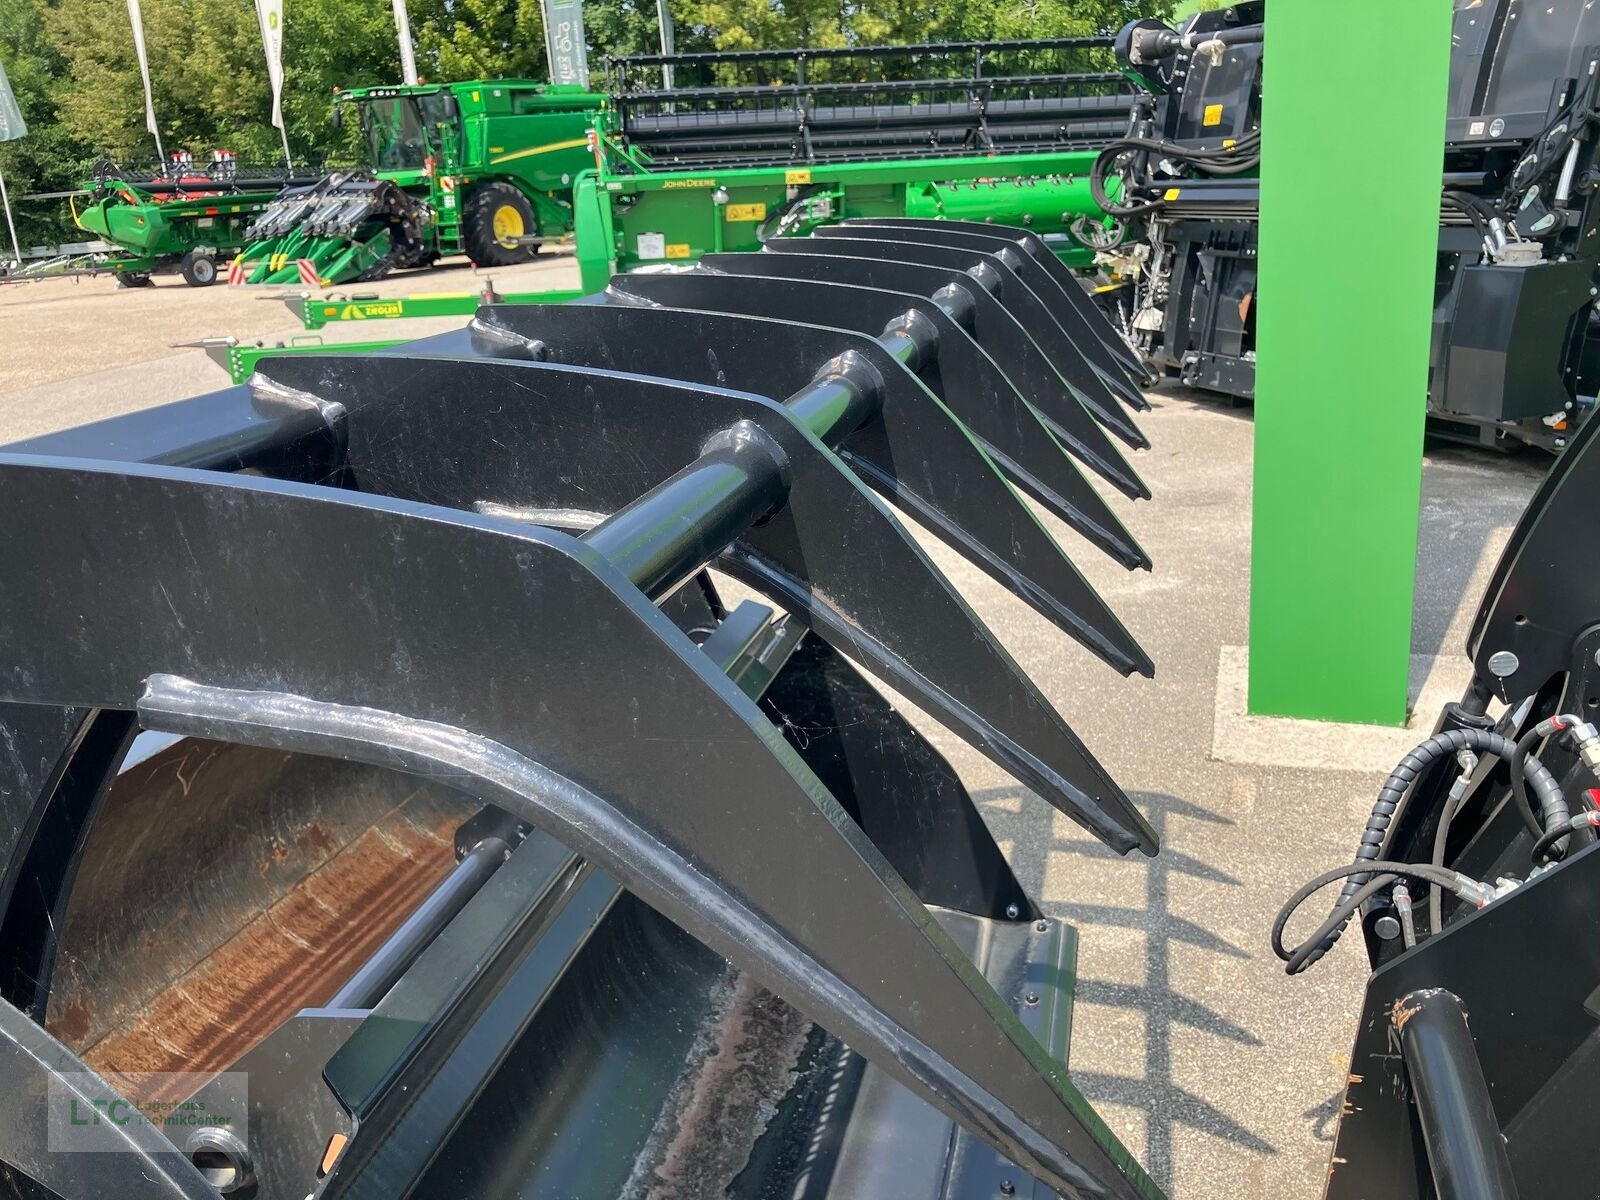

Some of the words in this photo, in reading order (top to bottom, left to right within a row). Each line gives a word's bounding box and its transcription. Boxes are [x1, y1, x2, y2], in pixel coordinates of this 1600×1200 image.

[662, 180, 686, 188] JOHN
[686, 179, 716, 187] DEERE
[365, 305, 400, 316] ZIEGLER
